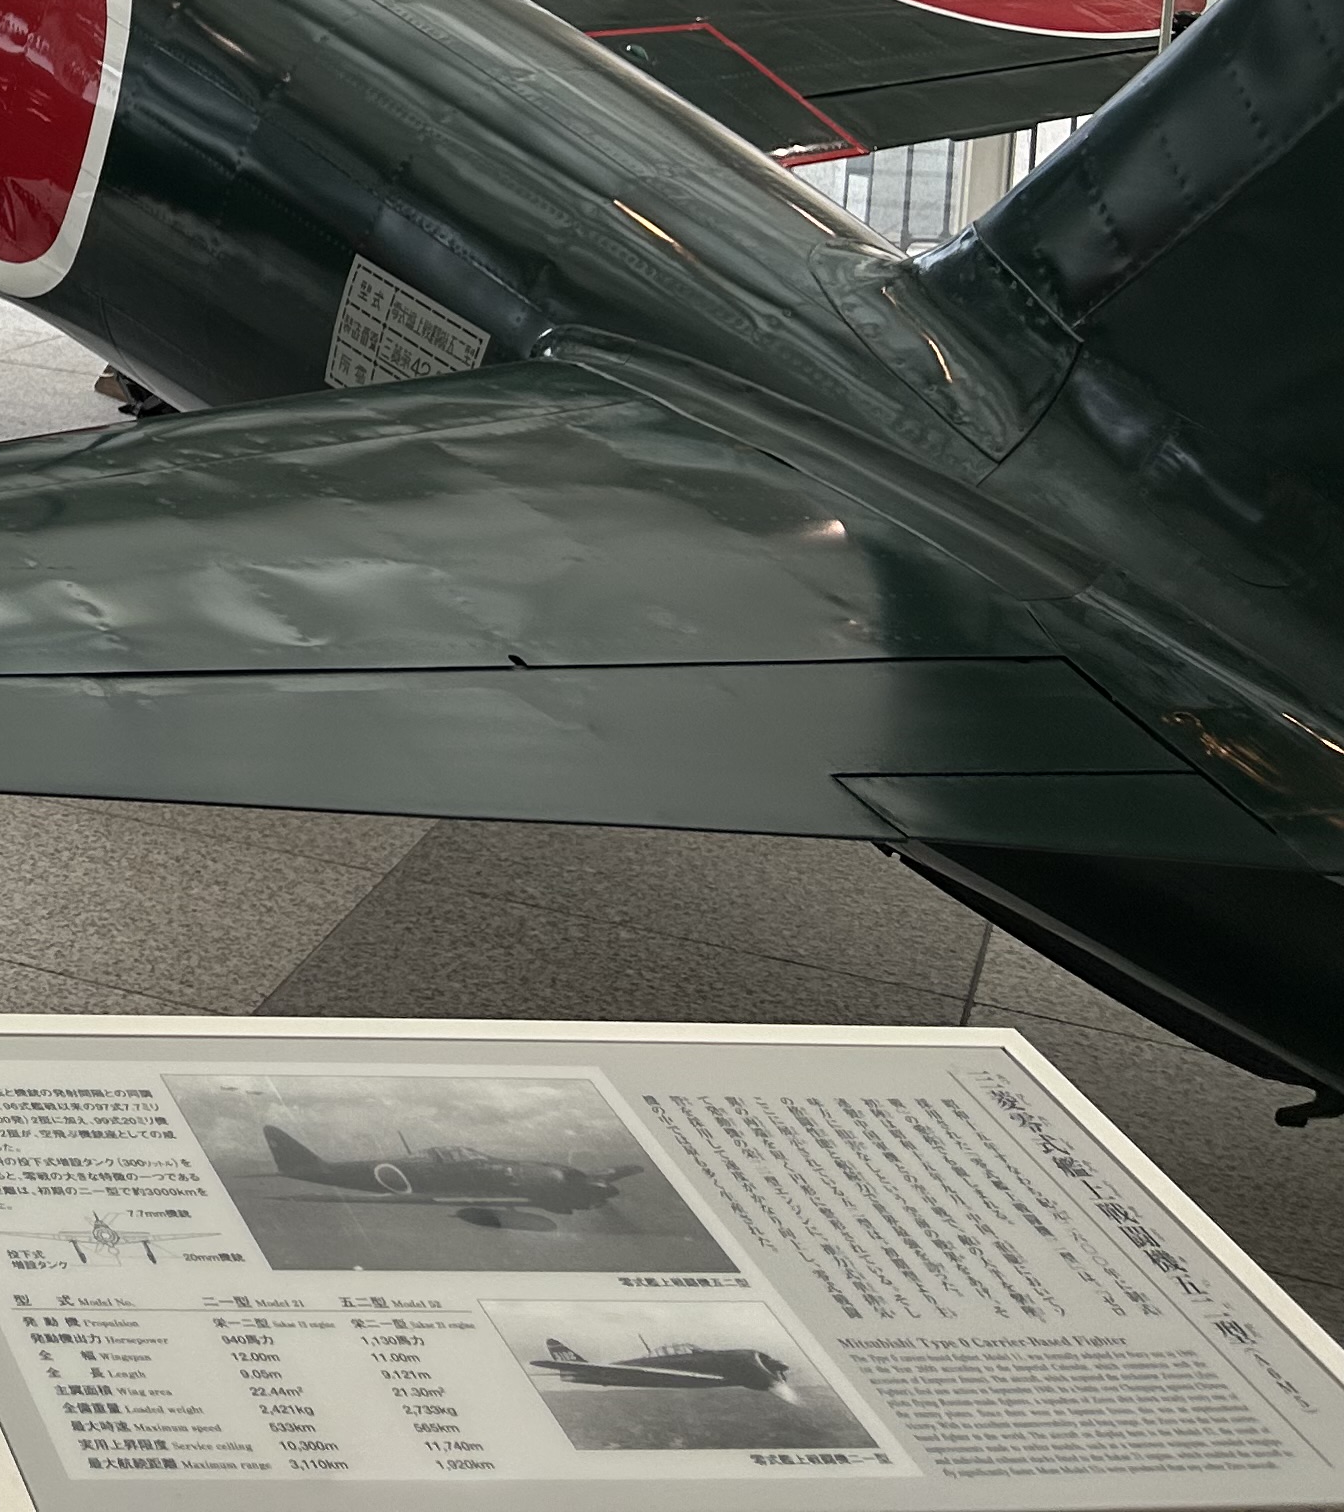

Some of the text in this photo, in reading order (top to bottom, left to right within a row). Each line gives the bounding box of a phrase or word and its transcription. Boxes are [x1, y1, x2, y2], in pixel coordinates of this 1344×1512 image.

[78, 1298, 113, 1307] Model
[202, 1296, 253, 1308] 二一型
[255, 1299, 290, 1307] Model
[292, 1300, 305, 1308] 21
[339, 1297, 390, 1309] 五二型
[391, 1300, 427, 1308] Model
[104, 1336, 168, 1345] Horsepower
[837, 1338, 916, 1349] Mitsubishi
[916, 1337, 958, 1350] Type
[971, 1336, 1073, 1348] Carrier-Based
[1072, 1336, 1129, 1348] Fighter
[231, 1352, 281, 1362] 12.00m
[371, 1353, 421, 1362] 11.00m
[107, 1370, 146, 1380] Length
[116, 1387, 147, 1397] Wing
[124, 1405, 165, 1414] Loaded
[168, 1405, 204, 1415] weight
[259, 1404, 315, 1416] 2,421kg
[133, 1423, 189, 1432] Maximum
[191, 1424, 222, 1433] speed
[171, 1441, 213, 1451] Service
[279, 1441, 339, 1452] 10,300m
[424, 1441, 484, 1452] 11,740m
[181, 1460, 238, 1470] Maximum
[289, 1459, 349, 1471] 3,110km
